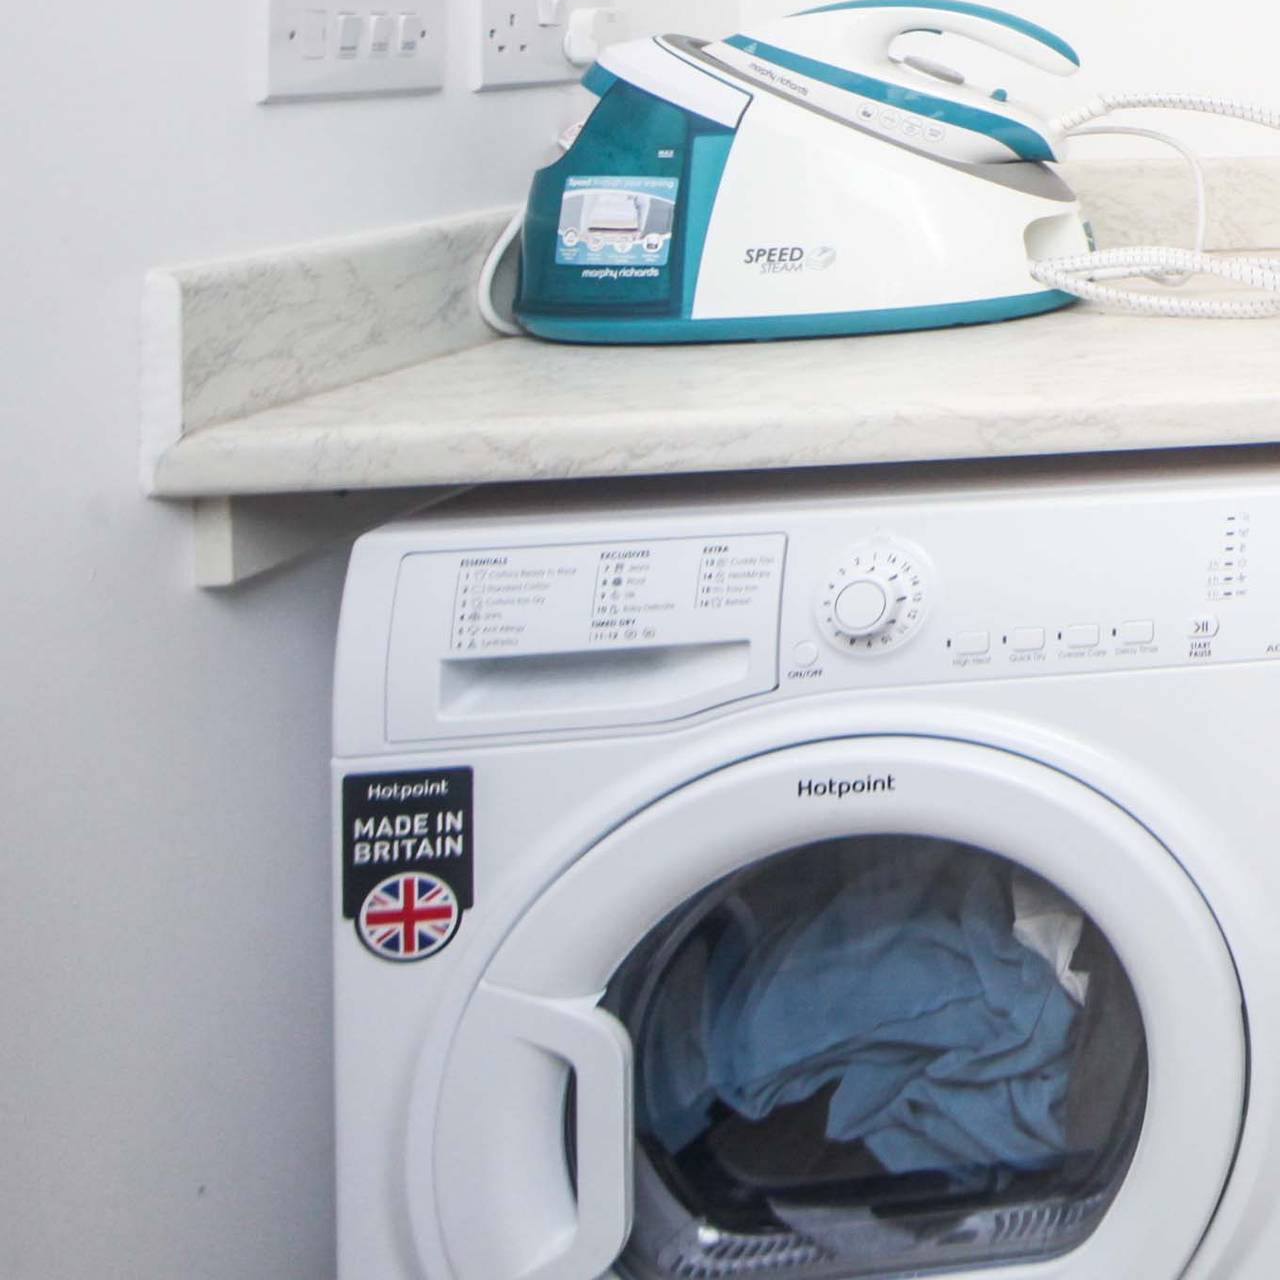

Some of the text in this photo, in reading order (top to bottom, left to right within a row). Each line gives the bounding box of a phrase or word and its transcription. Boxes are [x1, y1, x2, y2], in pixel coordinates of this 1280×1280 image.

[744, 246, 804, 264] SPEED
[581, 267, 660, 280] morphy richards
[367, 778, 449, 801] Hotpoint
[797, 773, 896, 799] Hotpoint
[353, 809, 464, 841] MADE IN
[353, 834, 464, 865] BRITAIN
